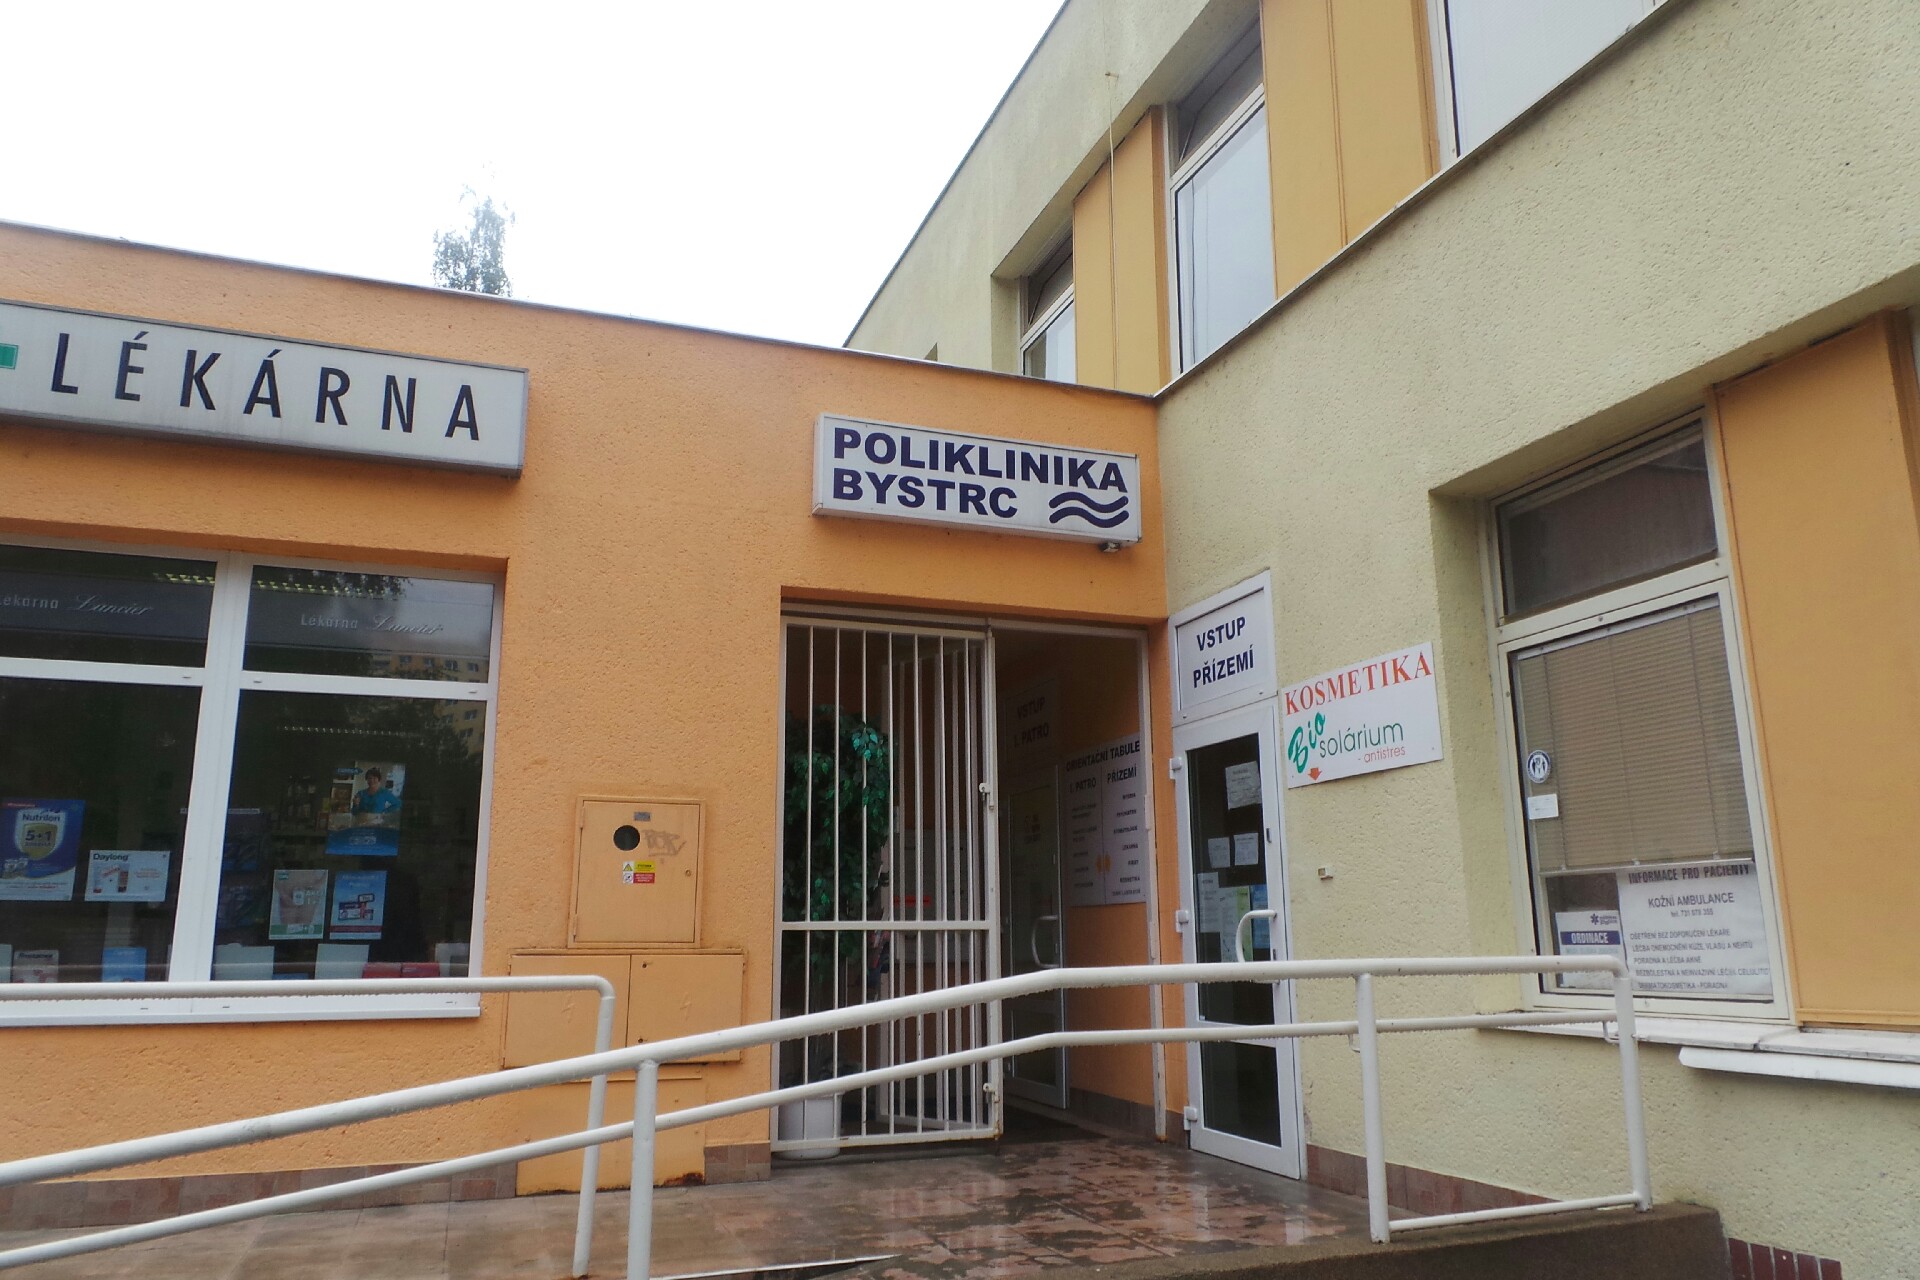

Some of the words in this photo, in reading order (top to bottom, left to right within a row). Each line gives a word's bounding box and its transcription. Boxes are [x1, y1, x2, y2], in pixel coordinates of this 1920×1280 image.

[51, 330, 480, 442] LÉKÁRNA
[834, 427, 1128, 493] POLIKLINIKA
[833, 467, 1018, 518] BYSTRC
[1196, 616, 1246, 651] VSTUP
[1193, 643, 1254, 688] PŘÍZEMÍ
[1285, 651, 1432, 716] KOSMETIKA
[1016, 696, 1046, 720] VSTUP
[1022, 722, 1049, 746] PATRO
[1287, 712, 1326, 774] Bio
[1319, 721, 1404, 758] solárium
[1110, 740, 1140, 760] TABULE
[1363, 744, 1406, 764] antistres
[1107, 763, 1137, 783] PŘÍZEMÍ
[22, 813, 60, 822] Nutrilon
[93, 853, 128, 861] Daylong
[1629, 869, 1678, 885] INFORMACE
[1682, 867, 1700, 880] PRO
[1704, 864, 1750, 879] PACIENTY
[1648, 894, 1675, 909] KOŽNÍ
[1677, 892, 1735, 906] AMBULANCE
[1571, 932, 1609, 943] ORDINACE
